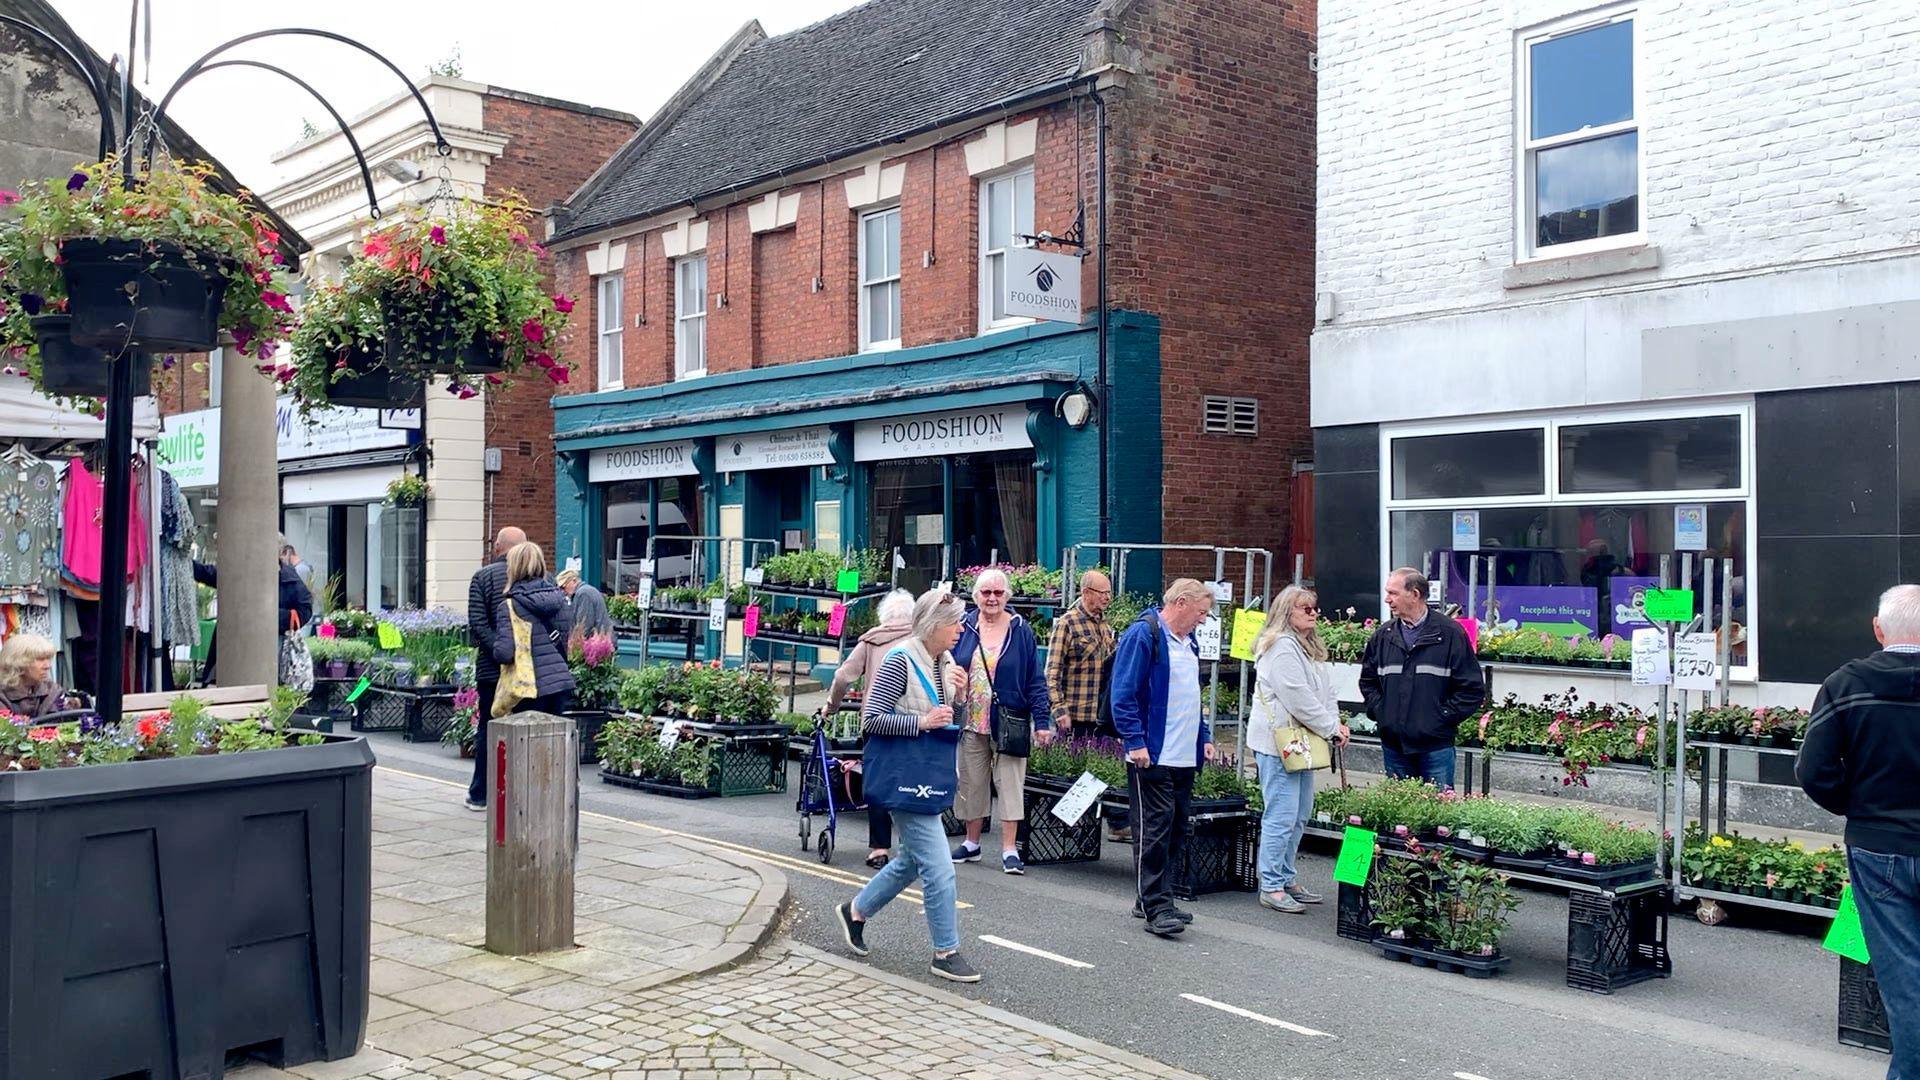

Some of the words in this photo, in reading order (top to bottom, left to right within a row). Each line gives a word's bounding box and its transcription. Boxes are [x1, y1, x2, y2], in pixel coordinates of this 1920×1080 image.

[1010, 291, 1078, 310] FOODSHION
[803, 429, 820, 441] Thai
[881, 413, 1004, 444] FOODSHION
[156, 422, 205, 465] ewlife
[903, 439, 980, 451] GARDEN
[606, 446, 684, 468] FOODSHION
[1520, 605, 1557, 616] Reception
[1559, 605, 1574, 615] this
[1576, 608, 1591, 617] way
[712, 615, 722, 627] £4
[1209, 629, 1219, 639] £6
[1634, 655, 1656, 675] £5
